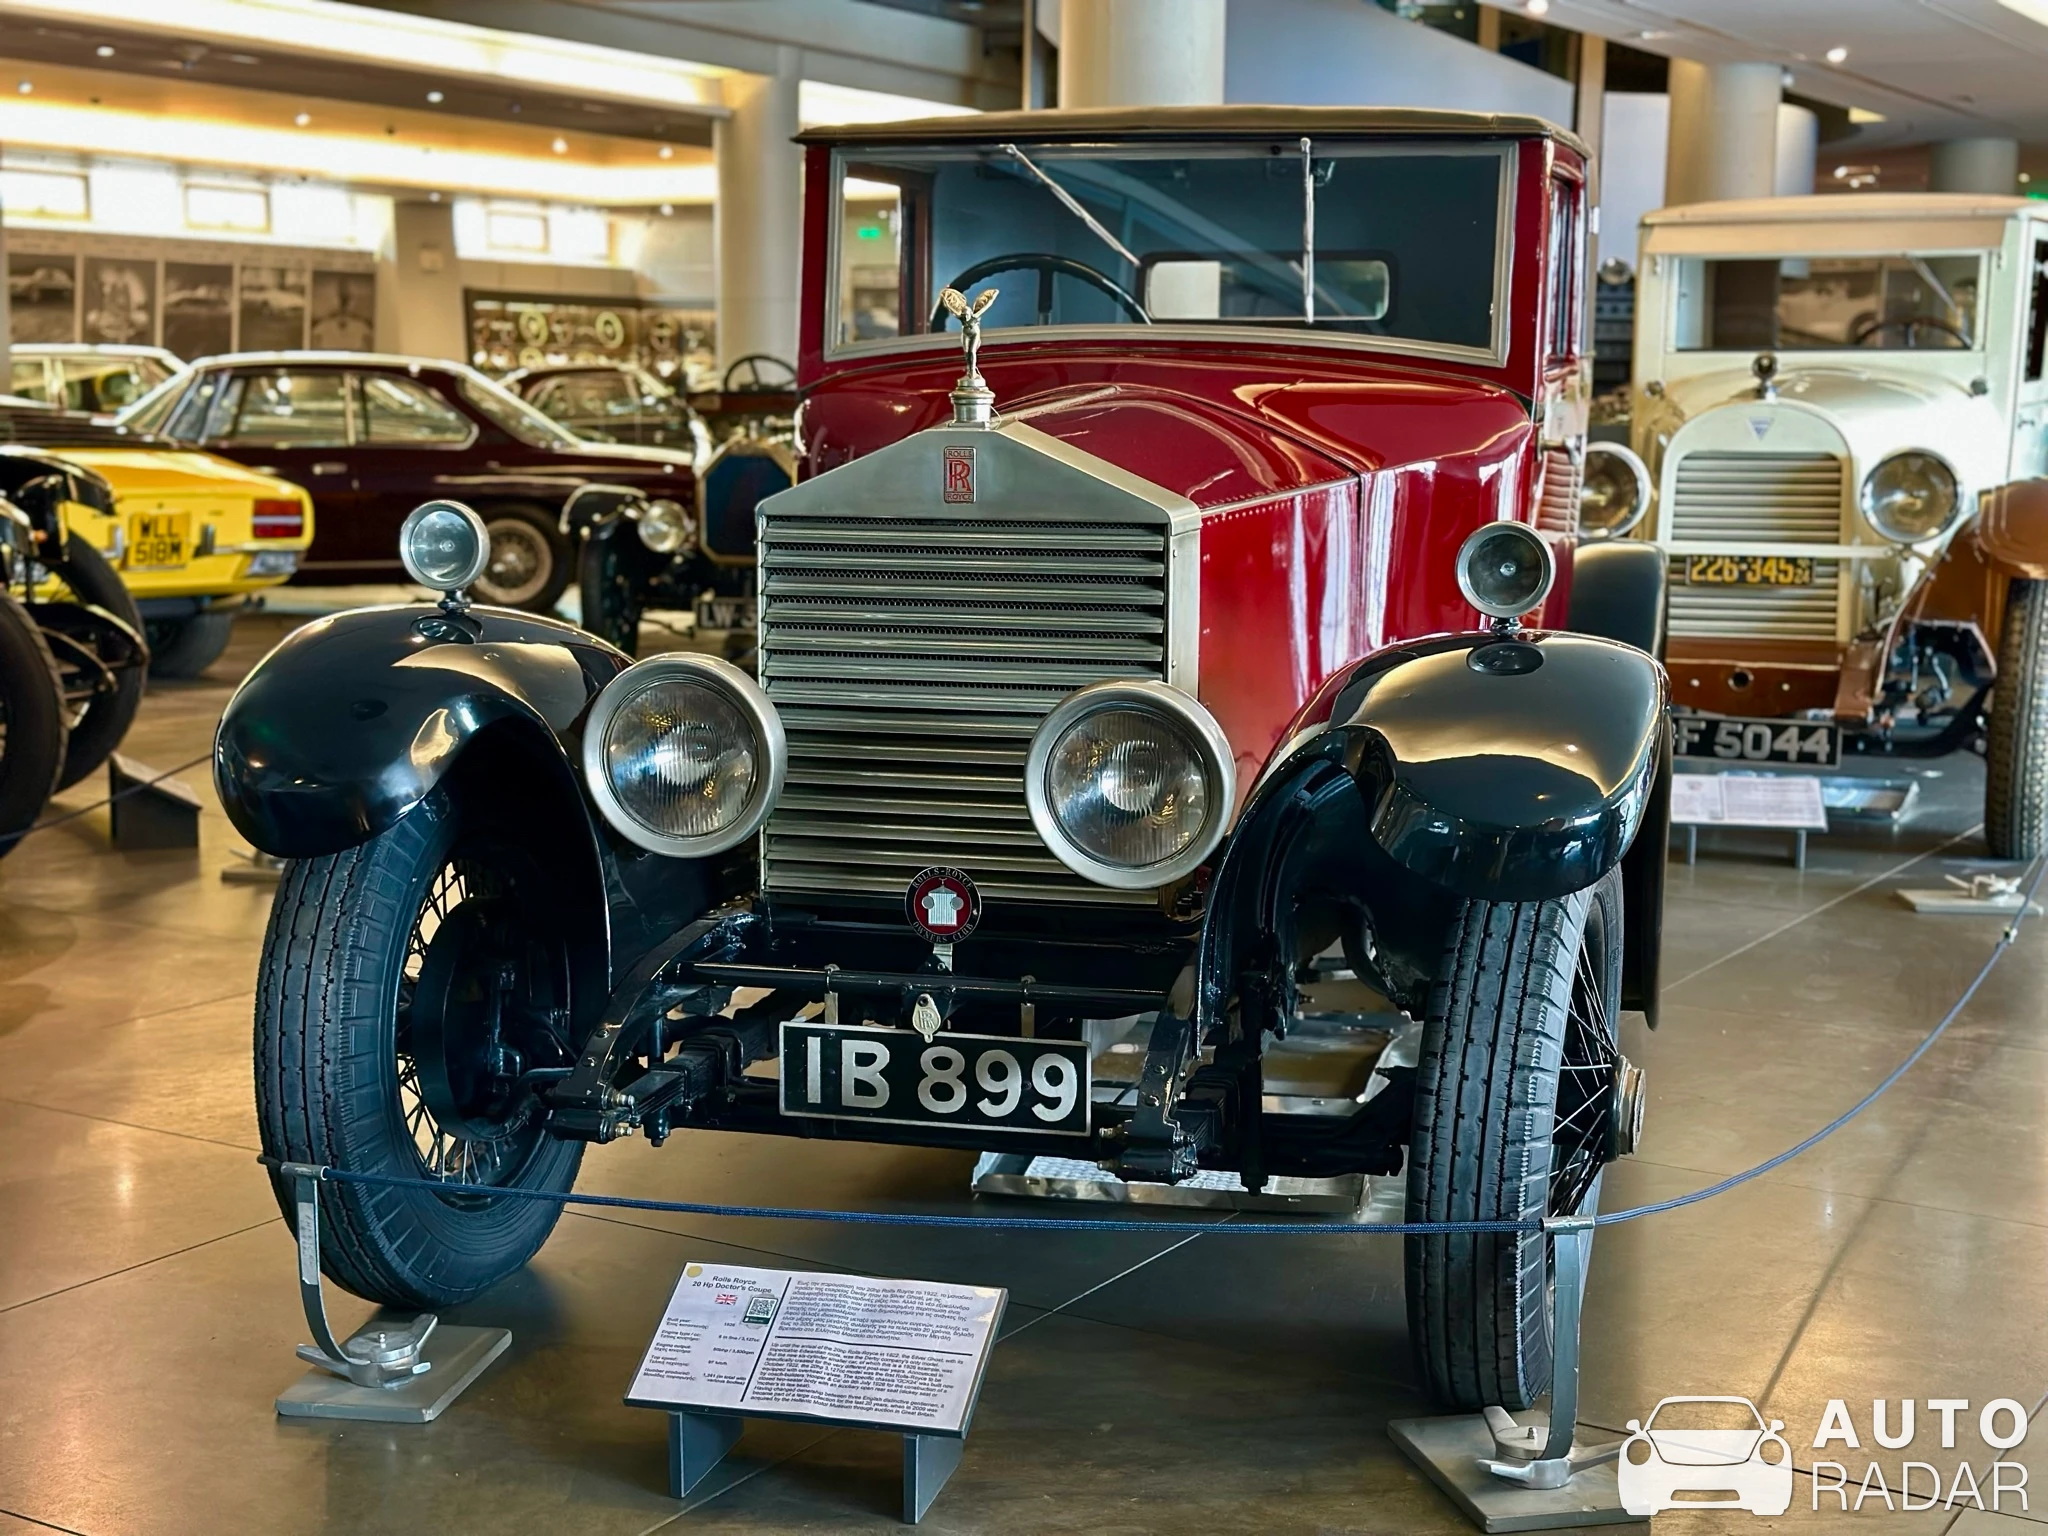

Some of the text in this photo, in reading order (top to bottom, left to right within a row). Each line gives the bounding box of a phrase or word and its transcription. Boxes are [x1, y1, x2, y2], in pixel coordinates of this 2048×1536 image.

[947, 450, 972, 458] ROLLS
[948, 459, 972, 491] RR
[947, 493, 972, 501] ROYCE
[140, 518, 179, 538] WLL
[1673, 719, 1830, 764] F 5044
[912, 867, 974, 890] ROLLS-ROYCE
[912, 921, 974, 943] OWNERS CLUB
[917, 1045, 1078, 1123] 899
[715, 1283, 747, 1291] Doctor's
[747, 1286, 772, 1294] Coupe
[732, 1277, 757, 1286] Royce
